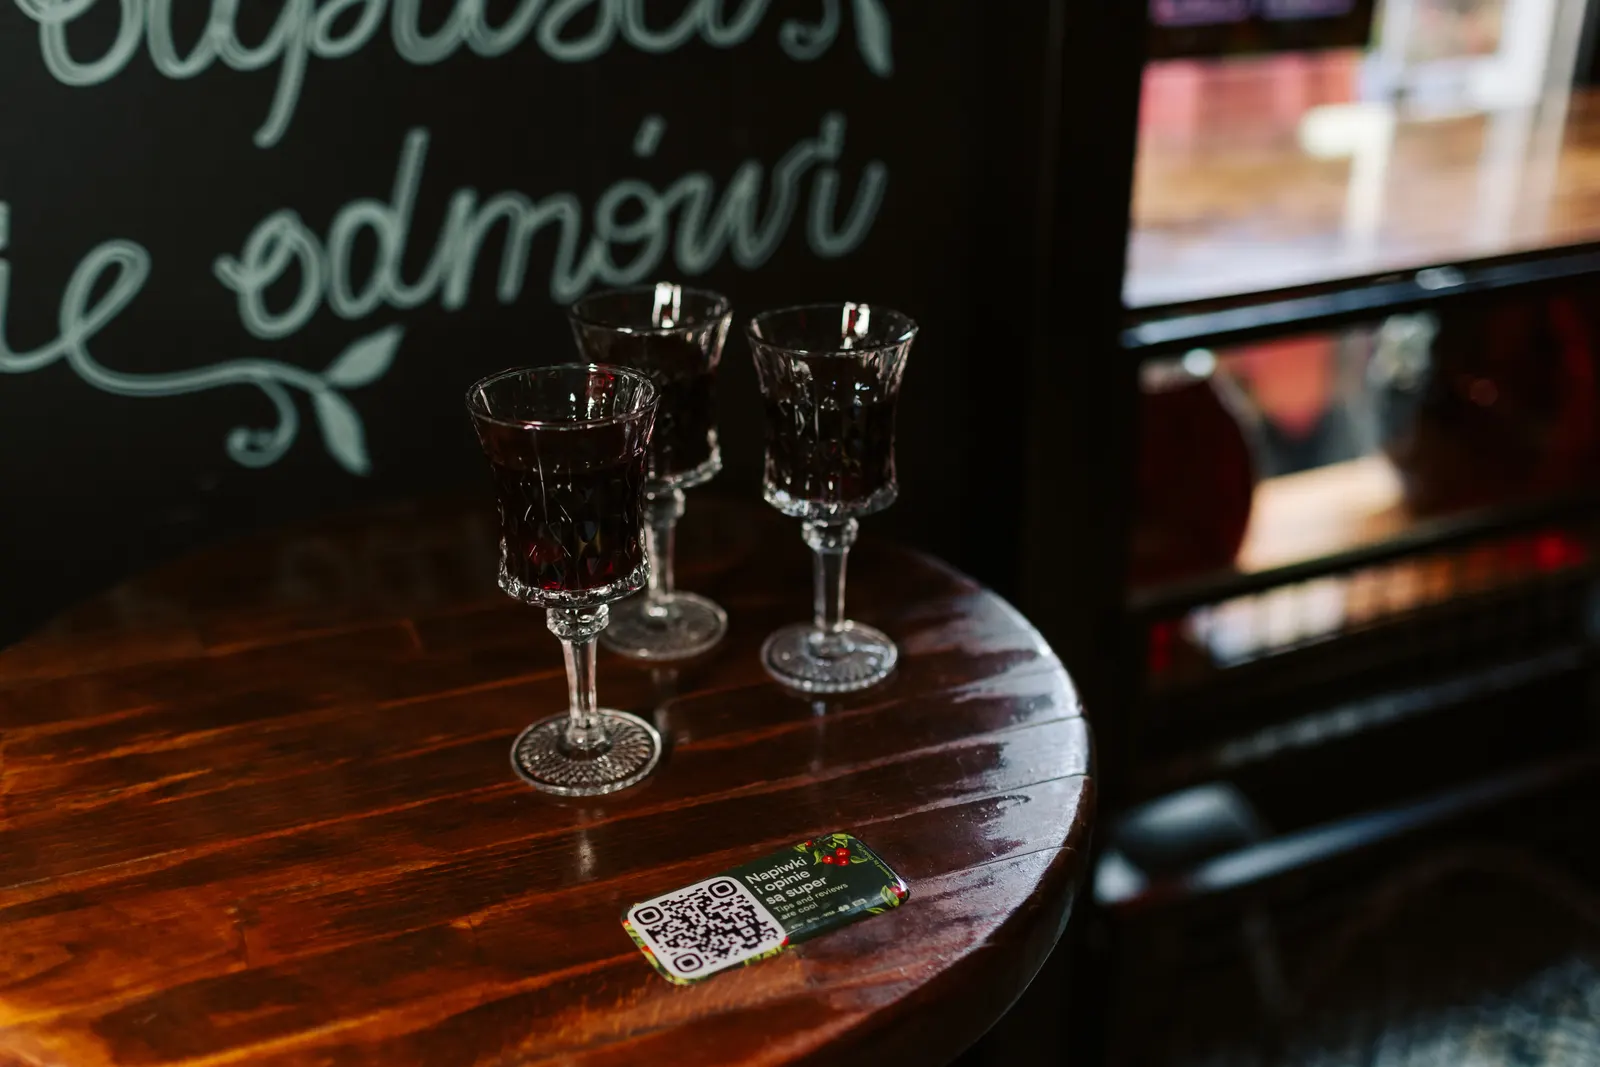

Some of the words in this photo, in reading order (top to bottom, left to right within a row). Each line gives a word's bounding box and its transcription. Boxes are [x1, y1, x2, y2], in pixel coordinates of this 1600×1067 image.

[213, 111, 887, 339] odmówi
[745, 856, 808, 885] Napiwki
[765, 870, 811, 893] opinie
[766, 893, 787, 905] są
[785, 876, 828, 898] super
[774, 903, 795, 914] Tips
[796, 895, 814, 906] and
[815, 883, 849, 899] reviews
[781, 911, 797, 920] are
[798, 902, 818, 914] cool
